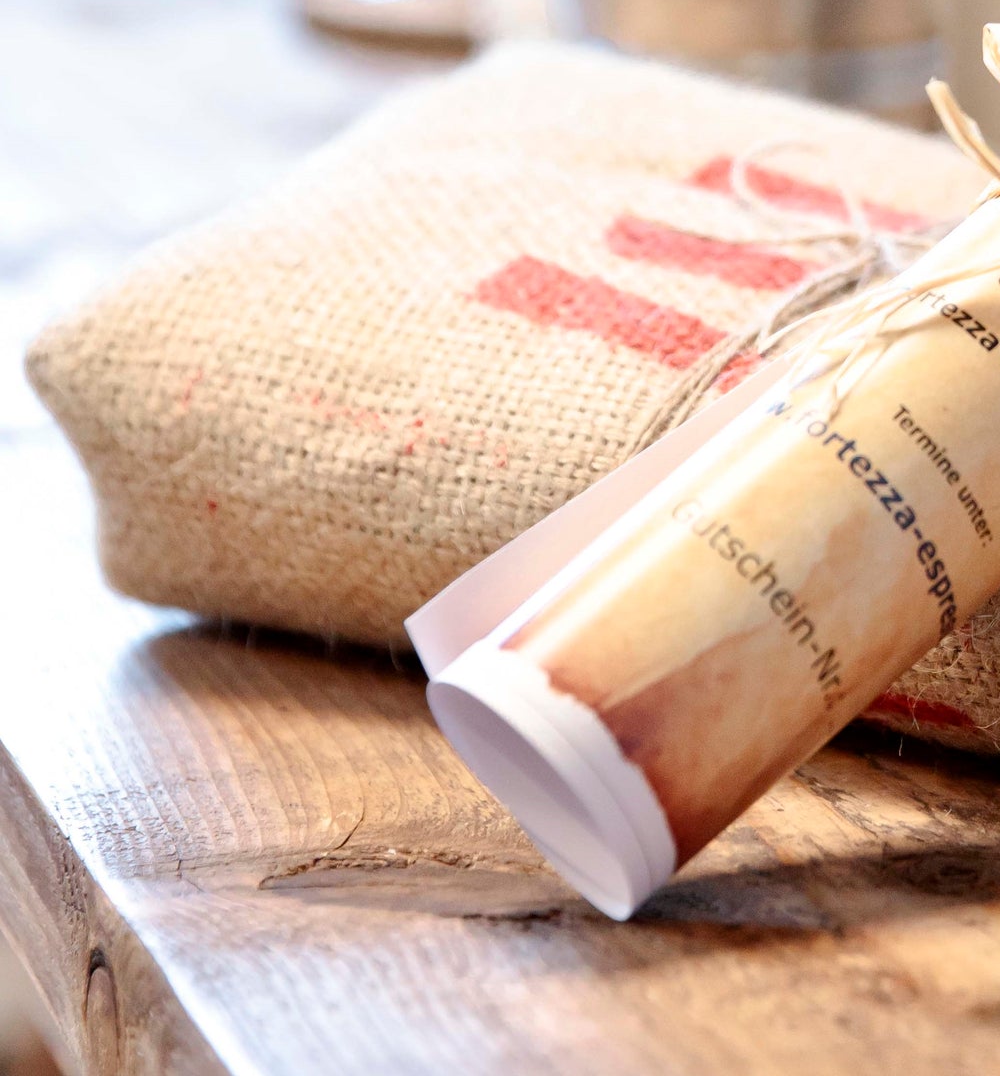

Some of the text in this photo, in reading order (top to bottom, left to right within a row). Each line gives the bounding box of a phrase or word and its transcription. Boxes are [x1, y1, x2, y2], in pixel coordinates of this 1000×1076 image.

[904, 286, 1000, 352] rtezza
[892, 404, 993, 548] Termine unter:
